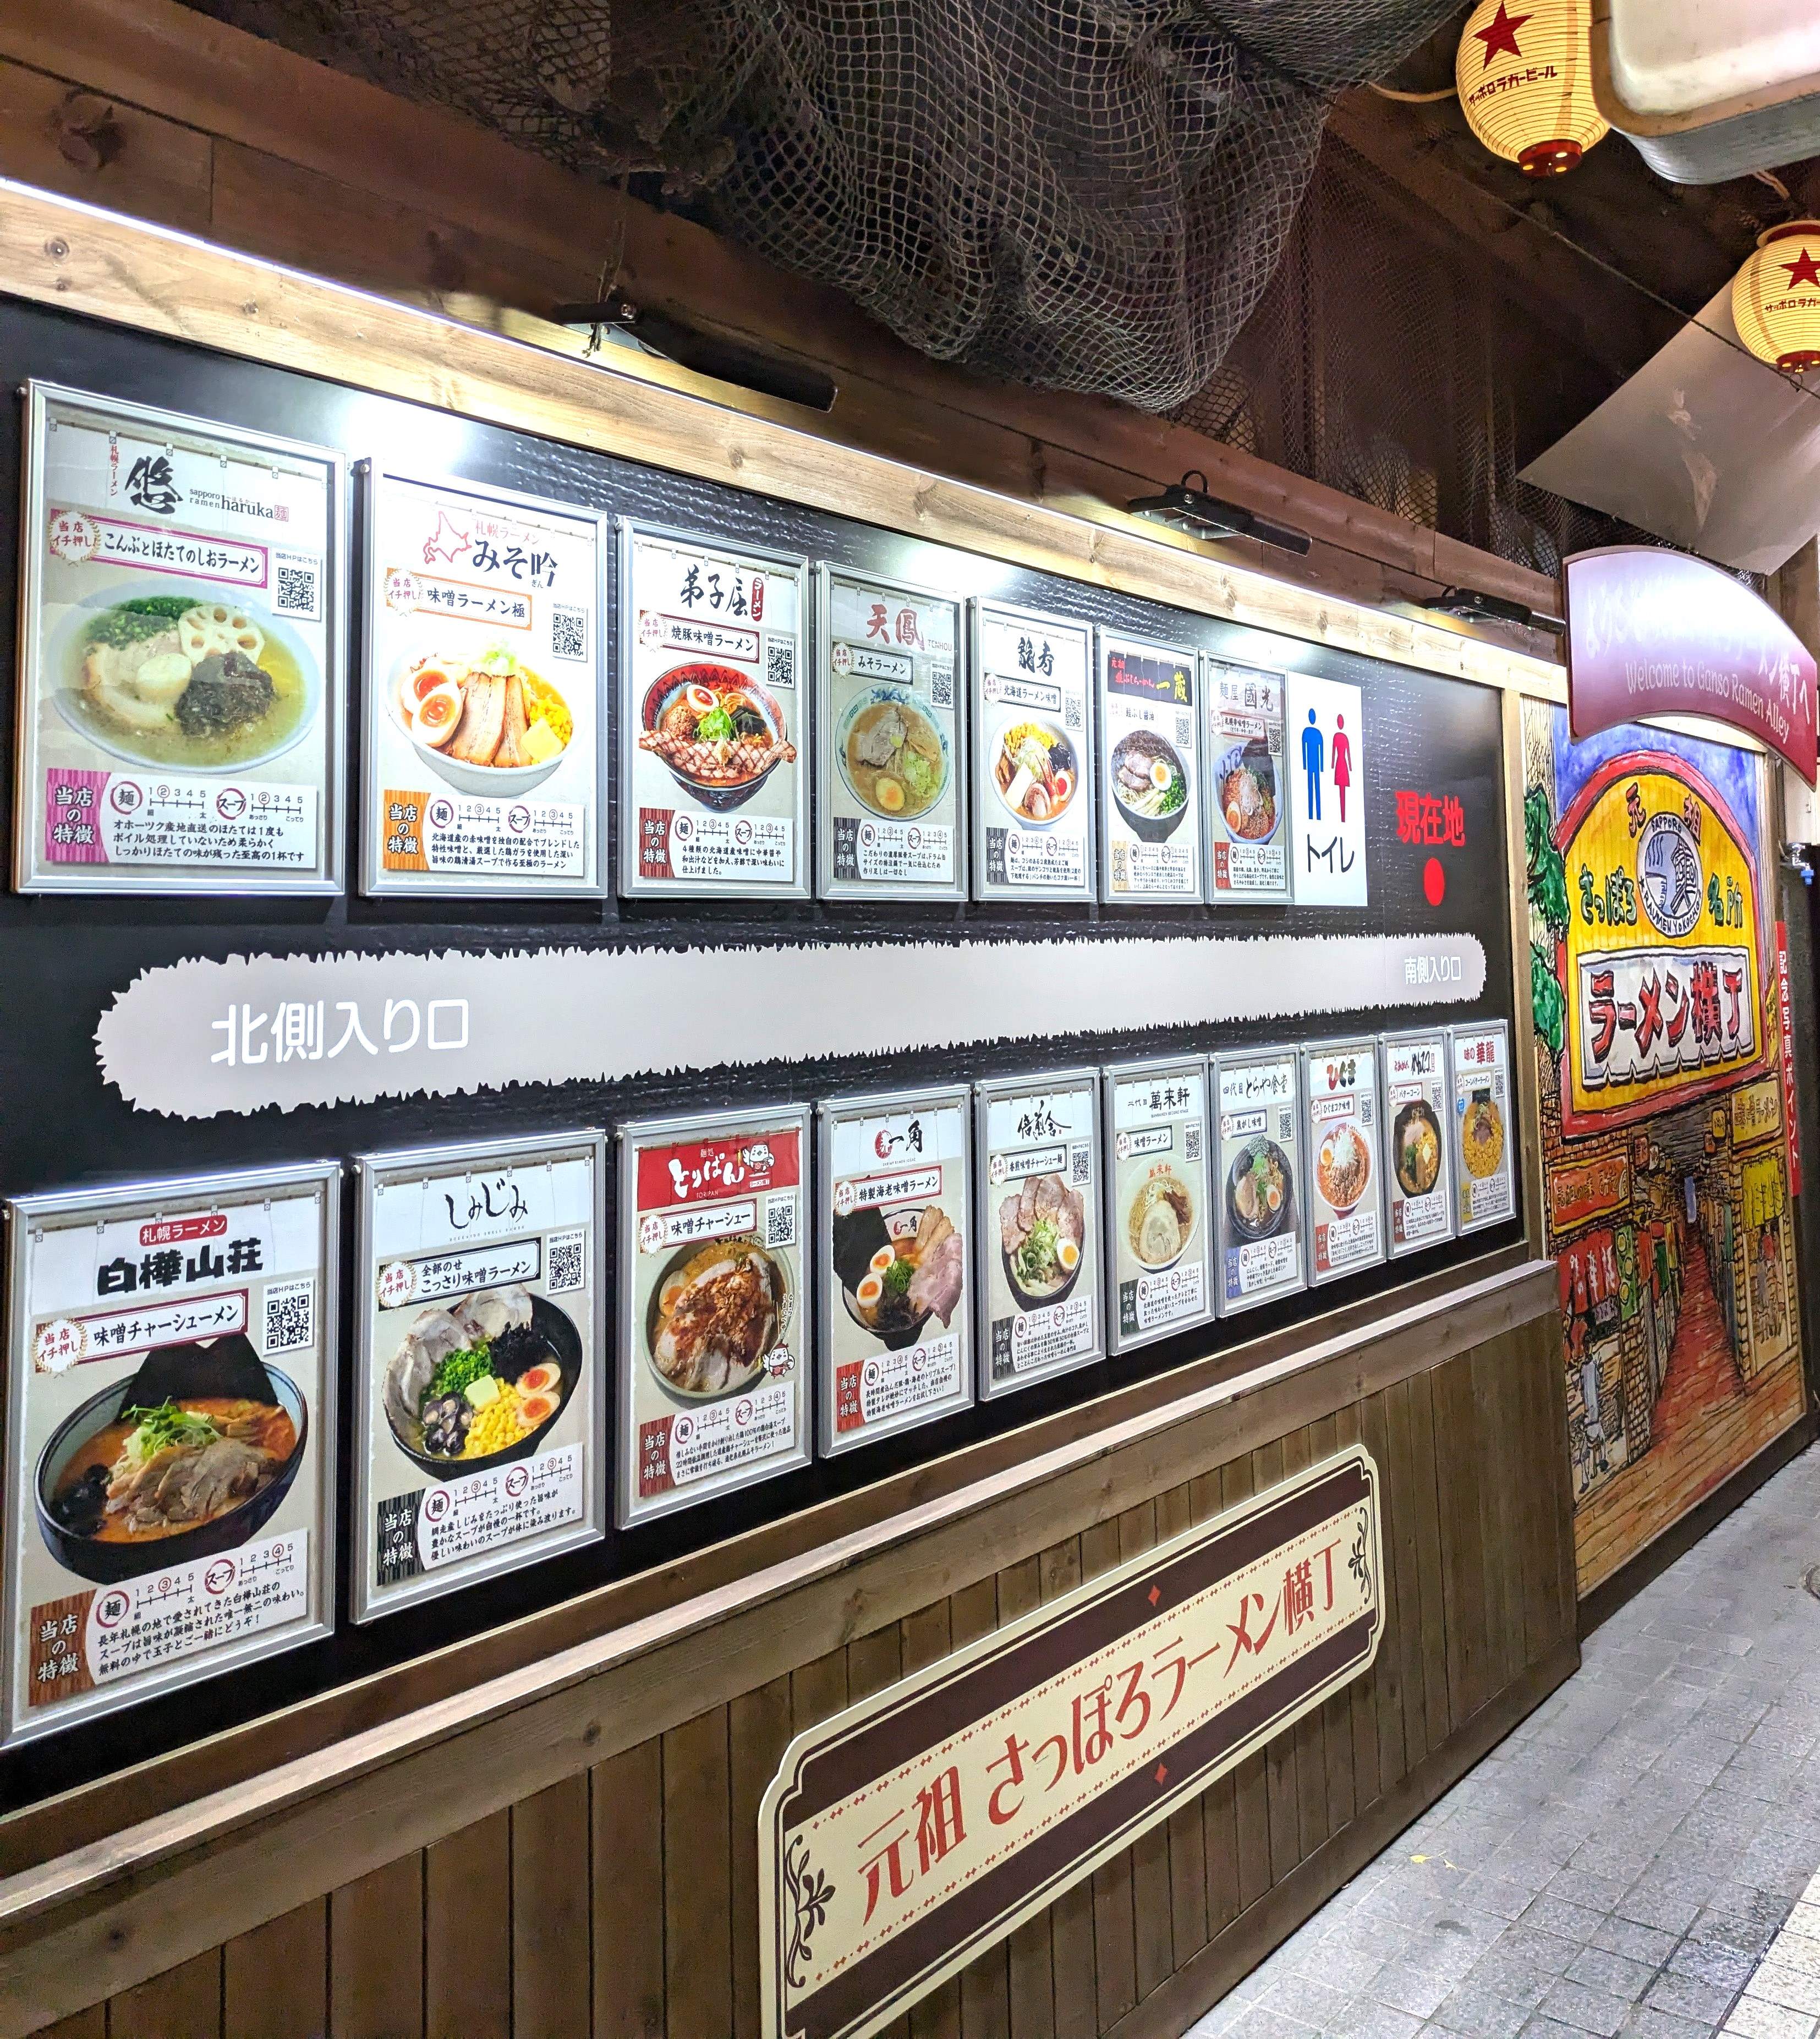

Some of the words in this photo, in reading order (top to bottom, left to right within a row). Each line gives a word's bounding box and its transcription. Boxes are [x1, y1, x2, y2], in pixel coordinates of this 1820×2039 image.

[1468, 65, 1558, 106] サッポロラガービール
[110, 445, 119, 496] 札幌ラーメン
[124, 456, 183, 514] 悠
[189, 488, 221, 501] sapporo
[221, 495, 273, 519] haruka
[58, 521, 83, 533] 当店
[475, 520, 540, 545] 札幌ラーメン
[105, 533, 259, 573] こんぶとほたてのしおラーメン
[473, 539, 558, 587] みそ吟
[393, 579, 411, 588] 当店
[680, 564, 748, 616] 弟子屈
[427, 588, 525, 617] 味噌ラーメン極
[752, 579, 763, 617] ラーメン
[644, 619, 659, 627] 当店
[866, 604, 925, 651] 天鳳
[671, 626, 754, 651] 焼豚味噌ラーメン
[858, 655, 906, 674] みそラーメン
[1004, 685, 1056, 704] 北海道ラーメン味噌
[1625, 657, 1679, 695] Welcome
[1682, 660, 1695, 688] to
[1697, 660, 1730, 698] Ganso
[1731, 674, 1764, 720] Ramen
[1765, 699, 1790, 744] Alley
[56, 786, 94, 807] 当店
[118, 790, 134, 805] 麺
[218, 796, 246, 810] スープ
[67, 808, 81, 824] の
[389, 804, 418, 821] 当店
[436, 807, 448, 821] 麺
[508, 813, 530, 826] スープ
[1395, 790, 1466, 847] 現在地
[53, 824, 94, 845] 特徴
[113, 820, 284, 837] オホーツク産地直送のほたては1度も
[398, 824, 408, 835] の
[644, 820, 666, 835] 当店
[679, 822, 688, 835] 麺
[735, 827, 752, 838] スープ
[837, 828, 853, 841] 当店
[864, 829, 872, 841] 麺
[113, 834, 273, 848] ボイル処理していないため柔らかく
[388, 836, 419, 854] 特徴
[650, 837, 659, 847] の
[990, 837, 1003, 849] 当店
[643, 848, 667, 863] 特徴
[837, 854, 855, 867] 特徴
[1307, 834, 1355, 874] トイレ
[682, 866, 723, 875] 仕上げました。
[989, 860, 1004, 872] 特徴
[1578, 862, 1637, 927] さっぽろ
[1404, 955, 1462, 985] 南側入り口
[1588, 961, 1744, 1064] ラーメン横丁
[210, 998, 470, 1067] 北側入り口
[1463, 1047, 1475, 1061] 味の
[1326, 1059, 1356, 1091] ひぐま
[1127, 1099, 1147, 1107] 二代目
[1149, 1087, 1190, 1110] 萬来軒
[889, 1120, 923, 1153] 一角
[1134, 1133, 1168, 1148] 味噌ラーメン
[668, 1153, 745, 1198] とりぱん
[696, 1190, 719, 1198] TORIPAN
[858, 1176, 938, 1202] 特製海老味噌ラーメン
[444, 1178, 528, 1230] しみじみ
[142, 1218, 226, 1243] 札幌ラーメン
[644, 1221, 659, 1233] 当店
[671, 1212, 750, 1236] 味噌チャーシュー
[97, 1236, 264, 1296] 白樺山荘
[422, 1259, 462, 1276] 全部のせ
[385, 1270, 404, 1282] 当店
[421, 1260, 531, 1293] こっさり味噌ラーメン
[266, 1281, 311, 1296] 当店HPはこちら
[92, 1303, 239, 1347] 味噌チャーシューメン
[44, 1328, 70, 1344] 当店
[995, 1328, 1009, 1342] 当店
[840, 1375, 857, 1391] 当店
[840, 1400, 858, 1417] 特徴
[679, 1423, 689, 1437] 麺
[644, 1432, 665, 1449] 当店
[643, 1459, 667, 1480] 特徴
[506, 1475, 528, 1489] スープ
[431, 1499, 443, 1514] 麺
[385, 1509, 412, 1532] 当店
[393, 1531, 404, 1543] の
[383, 1541, 413, 1567] 特徴
[205, 1566, 235, 1586] スープ
[106, 1599, 121, 1619] 麺
[40, 1613, 78, 1640] 当店
[51, 1641, 67, 1654] の
[37, 1653, 79, 1683] 特徴
[857, 1765, 969, 1929] 元祖
[985, 1537, 1343, 1830] さっぽろラーメン横丁
